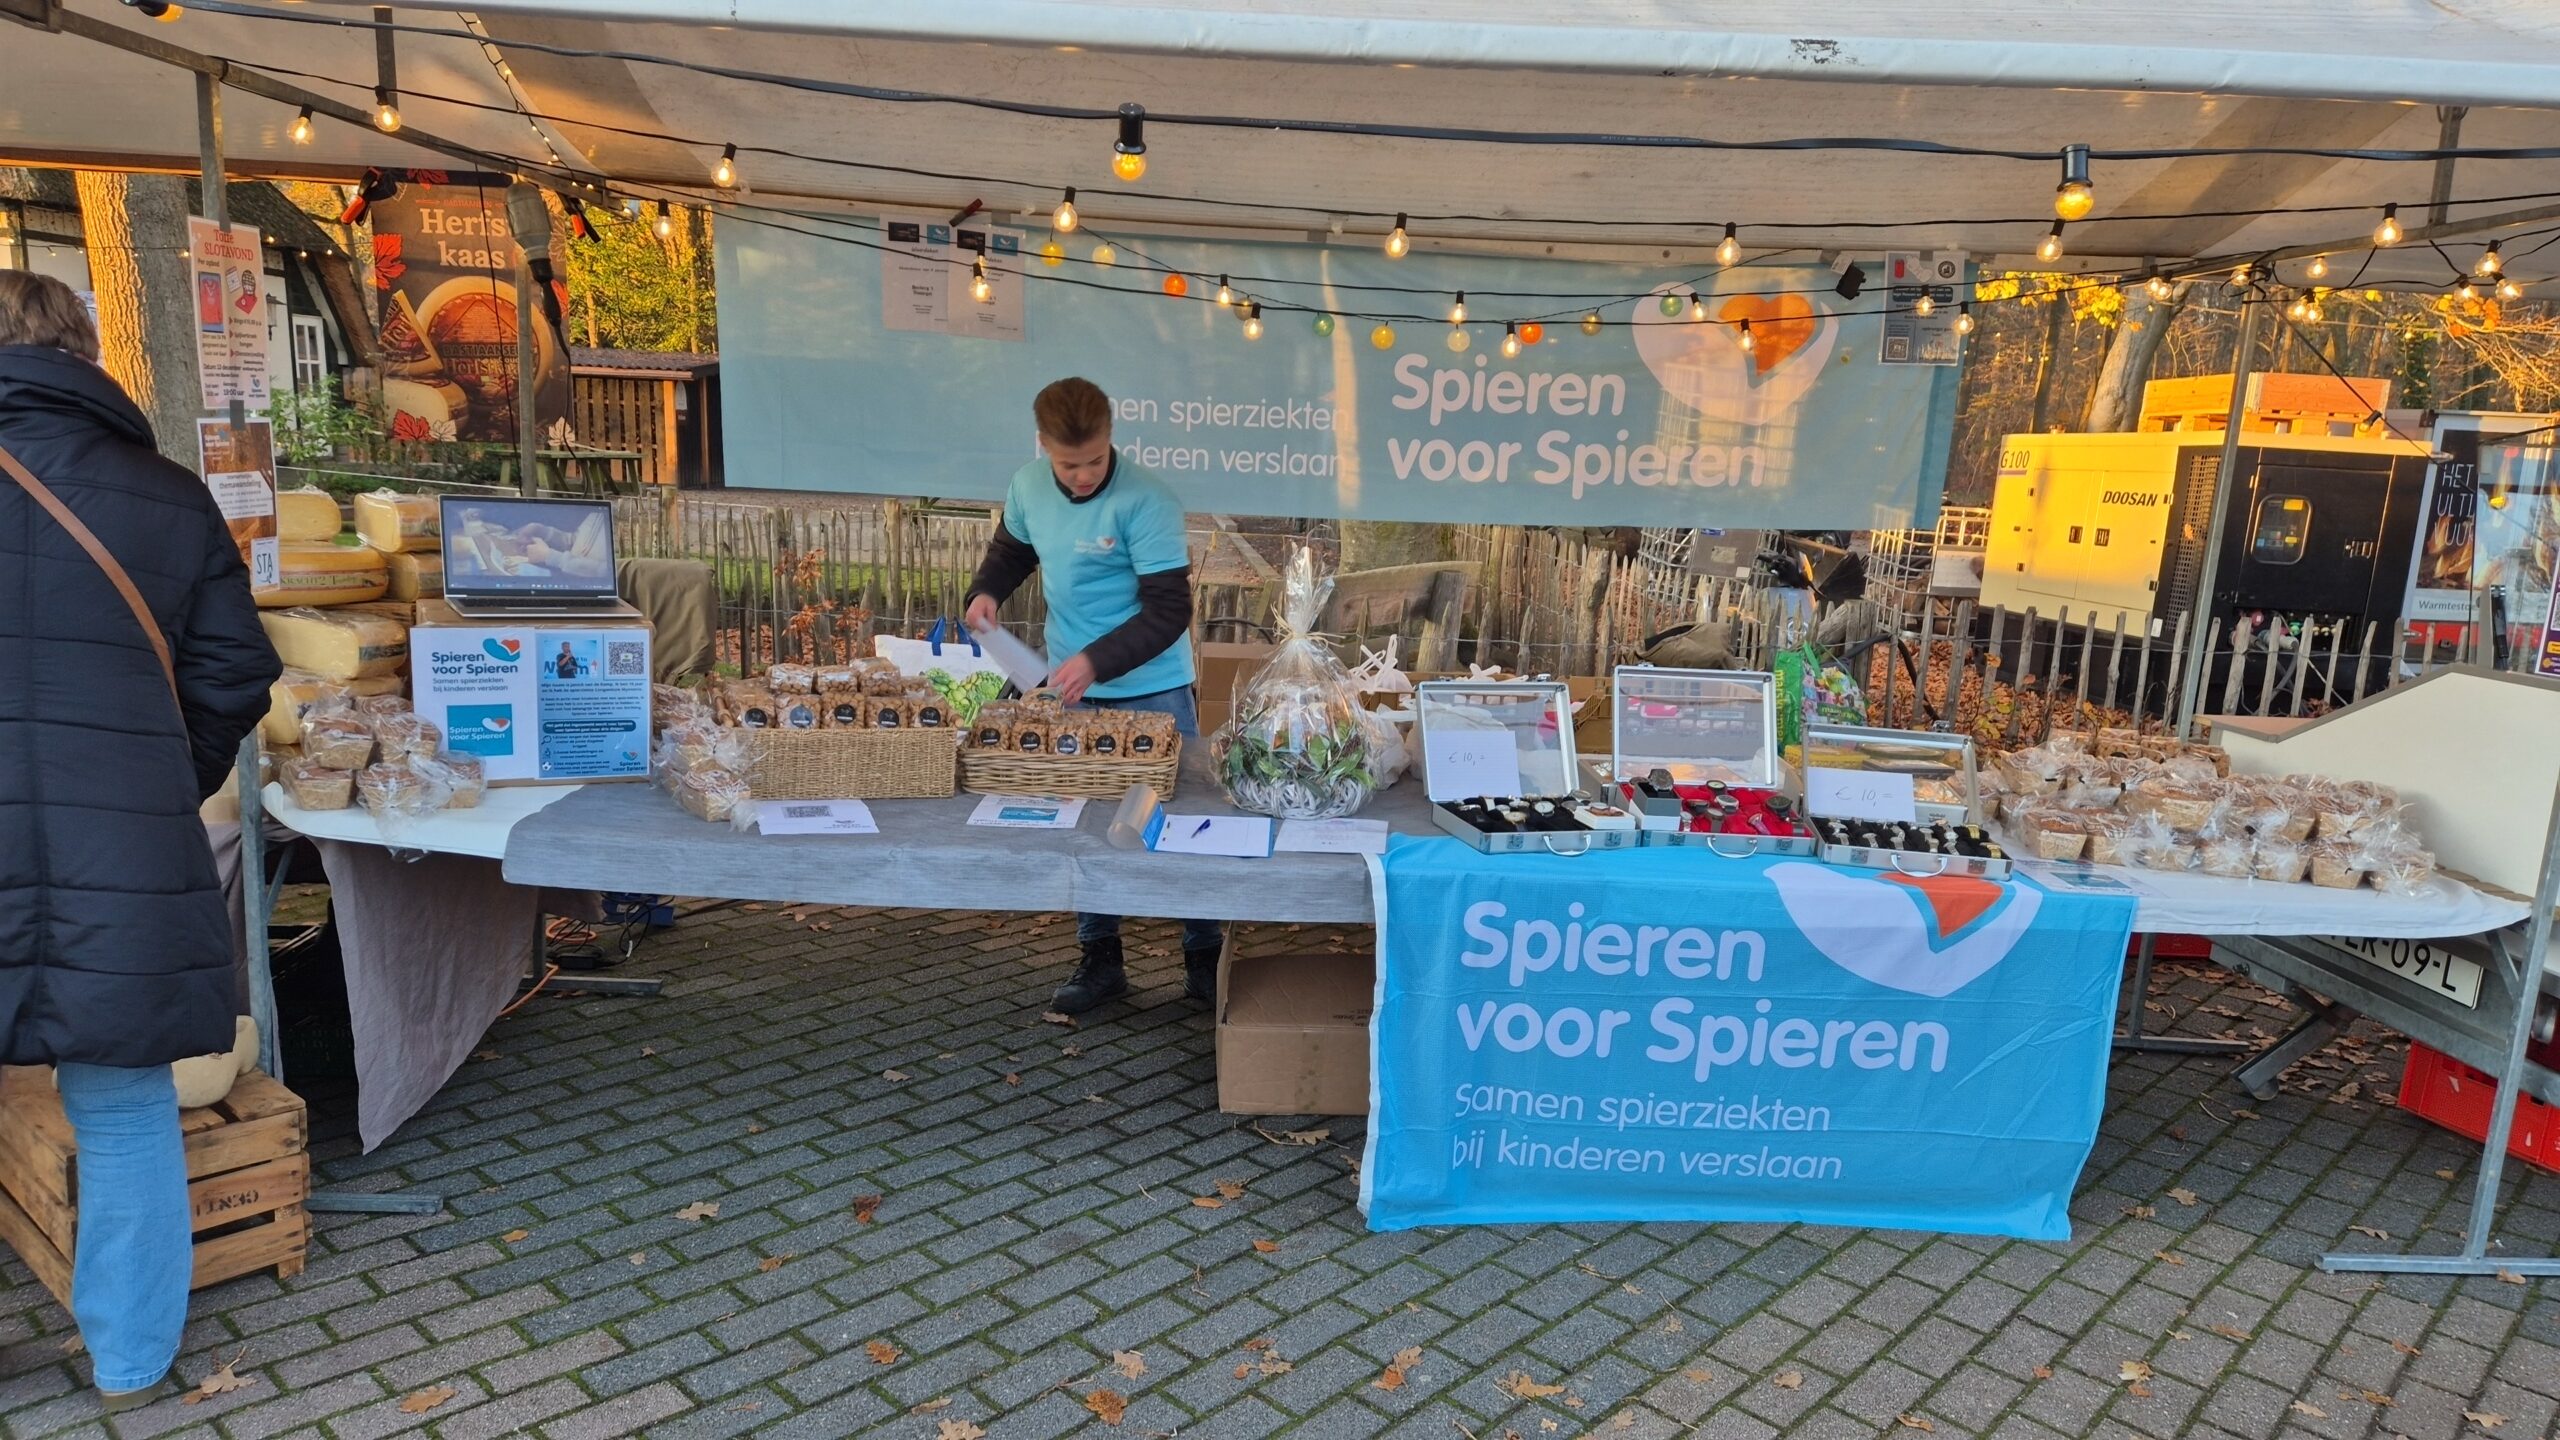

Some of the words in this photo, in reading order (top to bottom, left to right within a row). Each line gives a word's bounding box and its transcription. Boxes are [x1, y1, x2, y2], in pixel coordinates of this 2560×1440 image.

[420, 208, 510, 237] Herfs
[204, 242, 254, 261] SLOTAVOND
[437, 240, 506, 270] kaas
[1392, 353, 1626, 426] Spieren
[1169, 396, 1348, 432] spierziekten
[1219, 443, 1346, 478] verslaan
[1387, 437, 1522, 483] voor
[1534, 429, 1768, 499] Spieren
[2000, 450, 2030, 469] G100
[2442, 464, 2474, 488] HET
[2102, 490, 2158, 507] DOOSAN
[432, 651, 485, 664] Spieren
[432, 665, 463, 674] voor
[466, 663, 519, 676] Spieren
[443, 684, 476, 692] kinderen
[460, 676, 504, 685] spierziekten
[449, 726, 484, 734] Spieren
[471, 732, 505, 741] Spieren
[1460, 900, 1767, 987] Spieren
[1456, 1000, 1632, 1057] voor
[1645, 996, 1950, 1082] Spieren
[1597, 1092, 1831, 1133] spierziekten
[1451, 1129, 1486, 1170] bij
[1498, 1128, 1666, 1174] kinderen
[1680, 1146, 1843, 1180] verslaan
